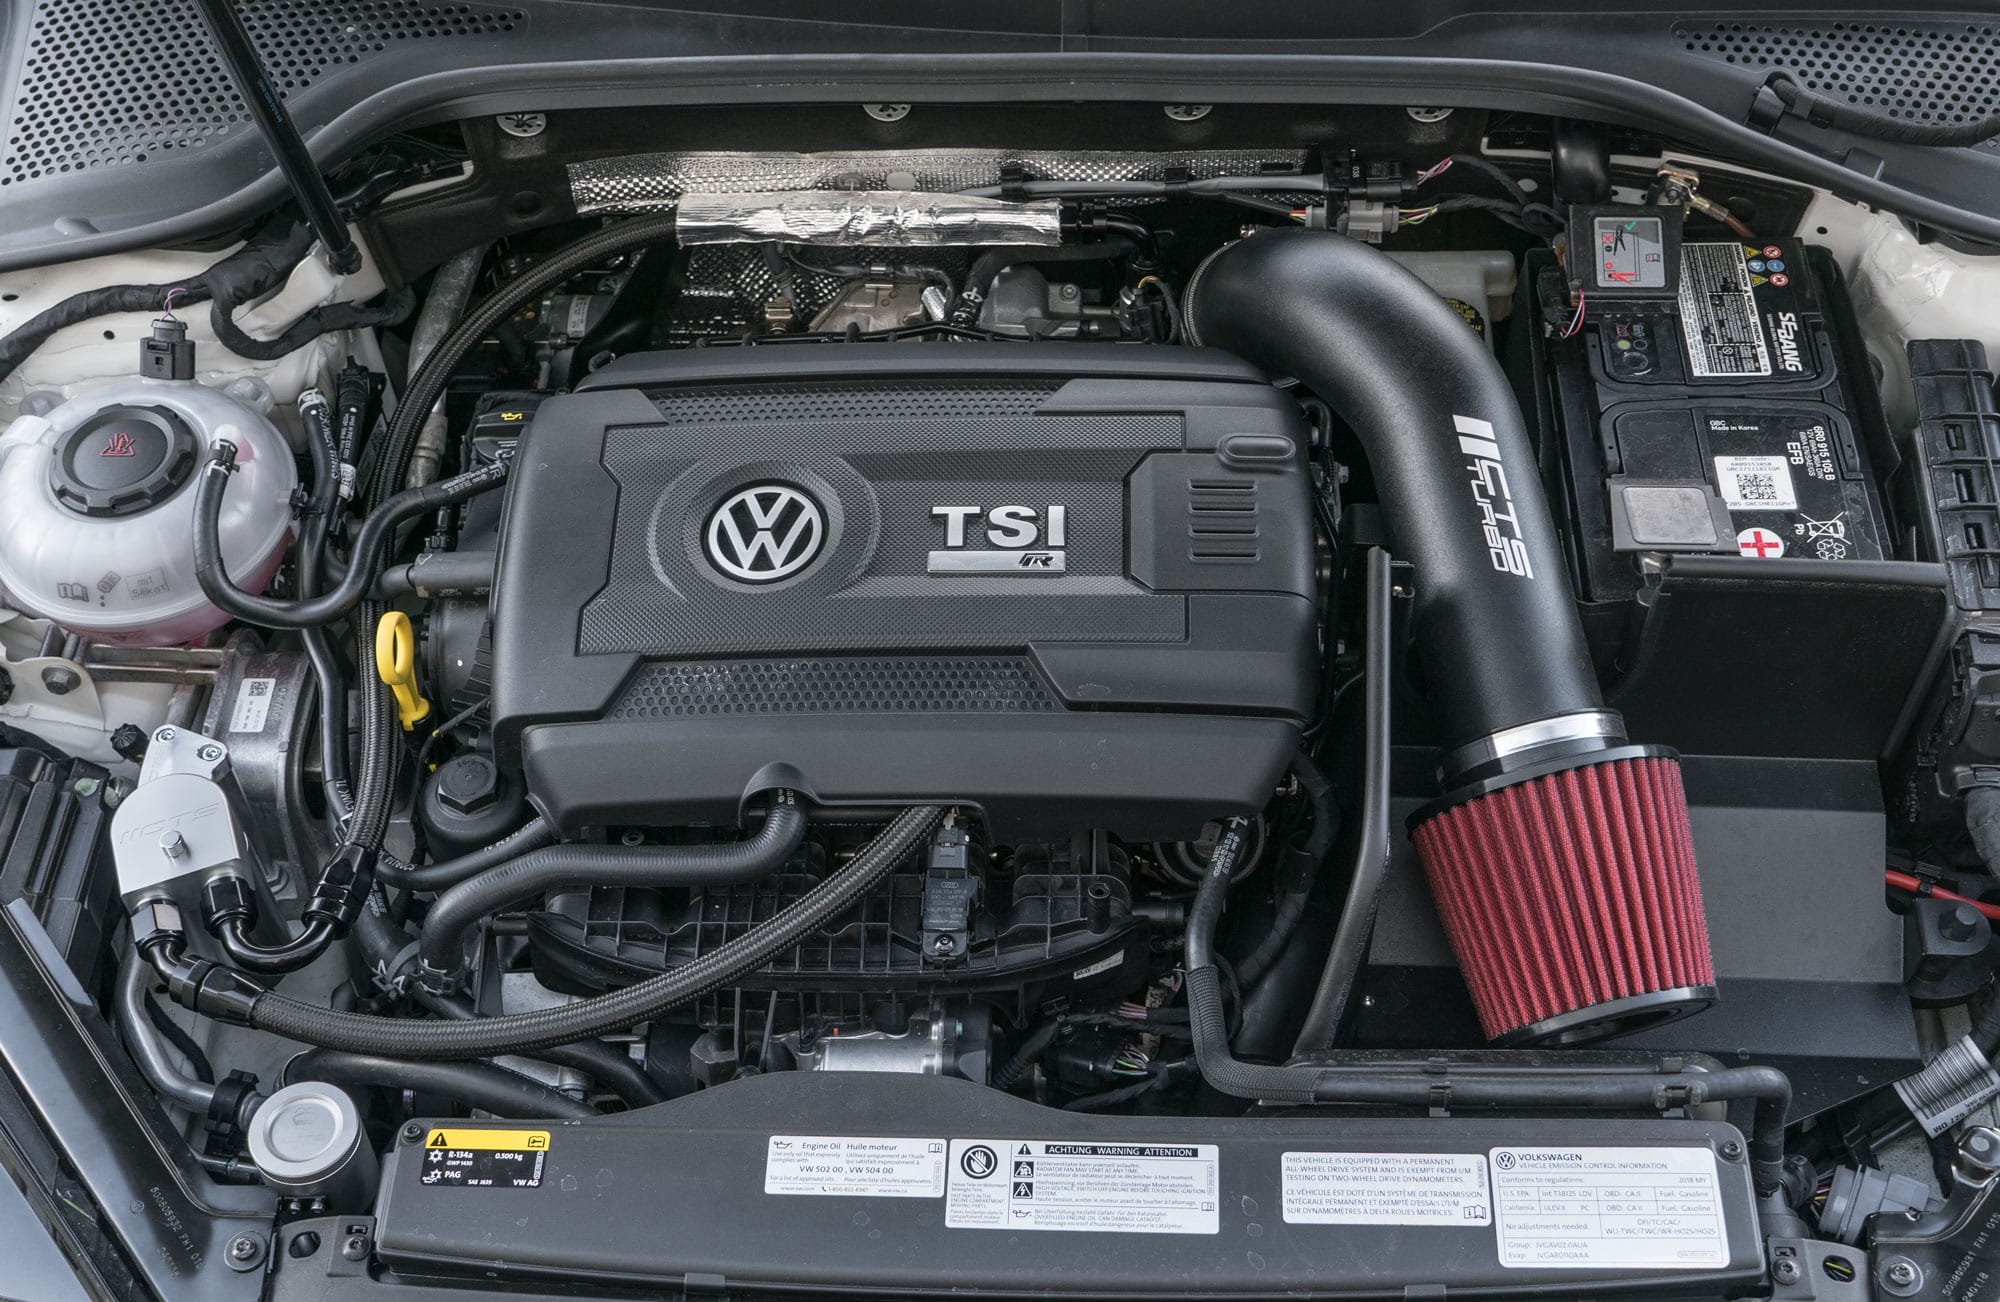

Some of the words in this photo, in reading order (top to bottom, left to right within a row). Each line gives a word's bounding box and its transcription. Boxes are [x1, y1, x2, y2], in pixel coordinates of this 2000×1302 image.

[1777, 312, 1803, 372] SEBANG
[1813, 426, 1826, 441] 6R0
[1787, 442, 1804, 465] EFB
[1817, 442, 1830, 457] 915
[1821, 459, 1834, 473] 105
[1466, 458, 1510, 573] TURBO
[1480, 459, 1535, 580] CTS
[932, 505, 1066, 548] TSI
[1794, 523, 1805, 535] Pb
[802, 1142, 829, 1151] Engine
[830, 1142, 841, 1150] Oil
[847, 1143, 867, 1151] Huile
[1049, 1146, 1092, 1154] ACHTUNG
[1097, 1147, 1140, 1155] WARNING
[1144, 1148, 1192, 1156] ATTENTION
[514, 1153, 523, 1161] kg
[1286, 1156, 1302, 1164] THIS
[1343, 1157, 1380, 1165] EQUIPPED
[1518, 1153, 1583, 1161] VOLKSWAGEN
[444, 1170, 461, 1178] PAG
[1429, 1190, 1483, 1198] TRANSMISSION
[1391, 1208, 1415, 1216] ROUES
[1517, 1223, 1561, 1231] adjustments
